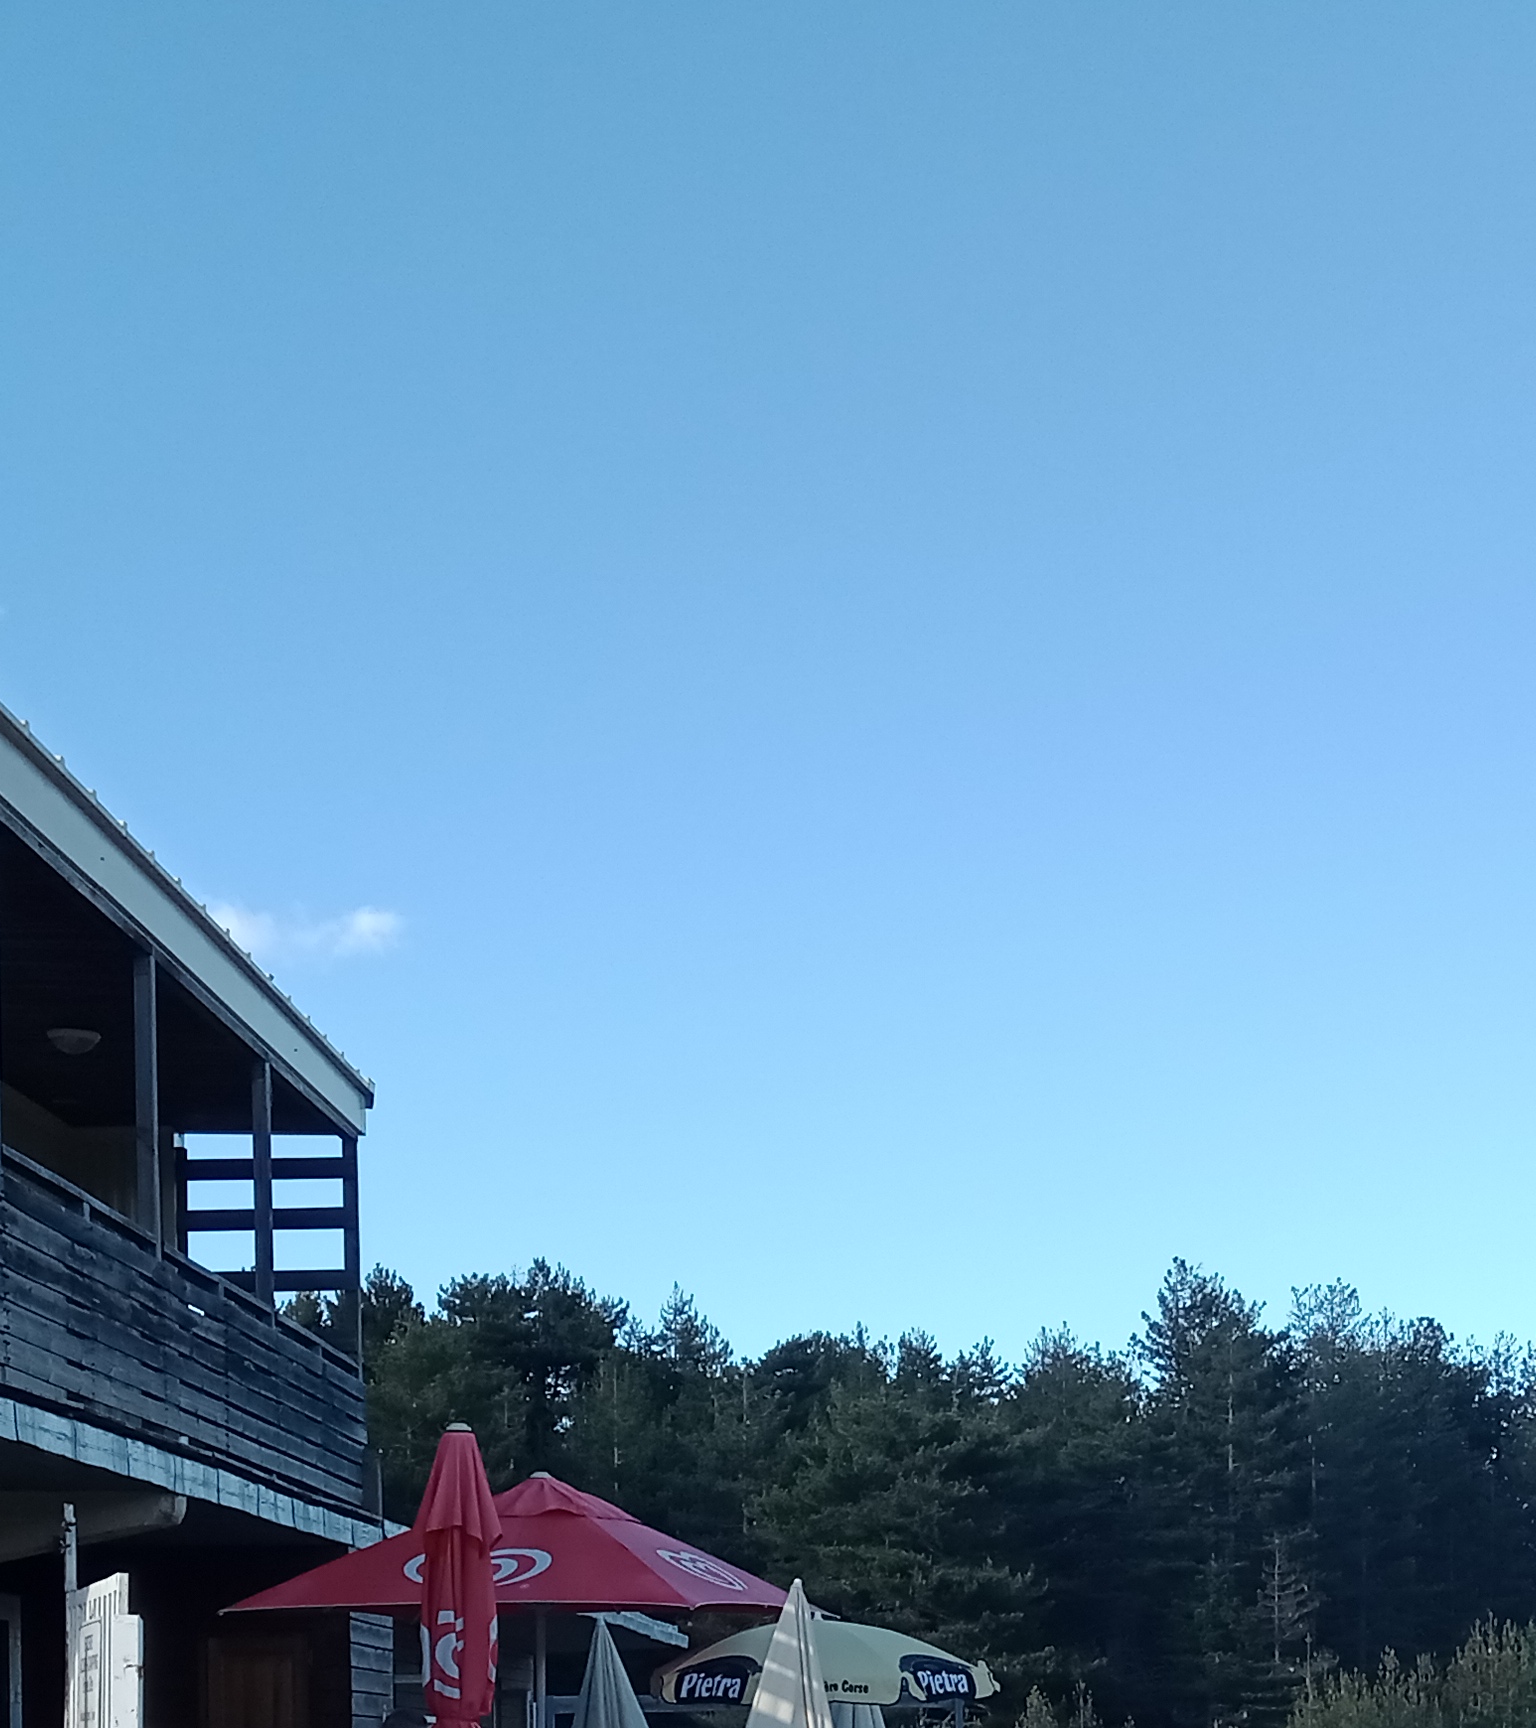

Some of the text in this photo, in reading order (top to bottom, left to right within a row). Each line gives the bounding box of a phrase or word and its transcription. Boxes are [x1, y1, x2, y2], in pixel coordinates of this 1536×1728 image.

[679, 1672, 742, 1699] Pietra
[841, 1679, 869, 1694] Corse
[917, 1669, 970, 1696] Pietra
